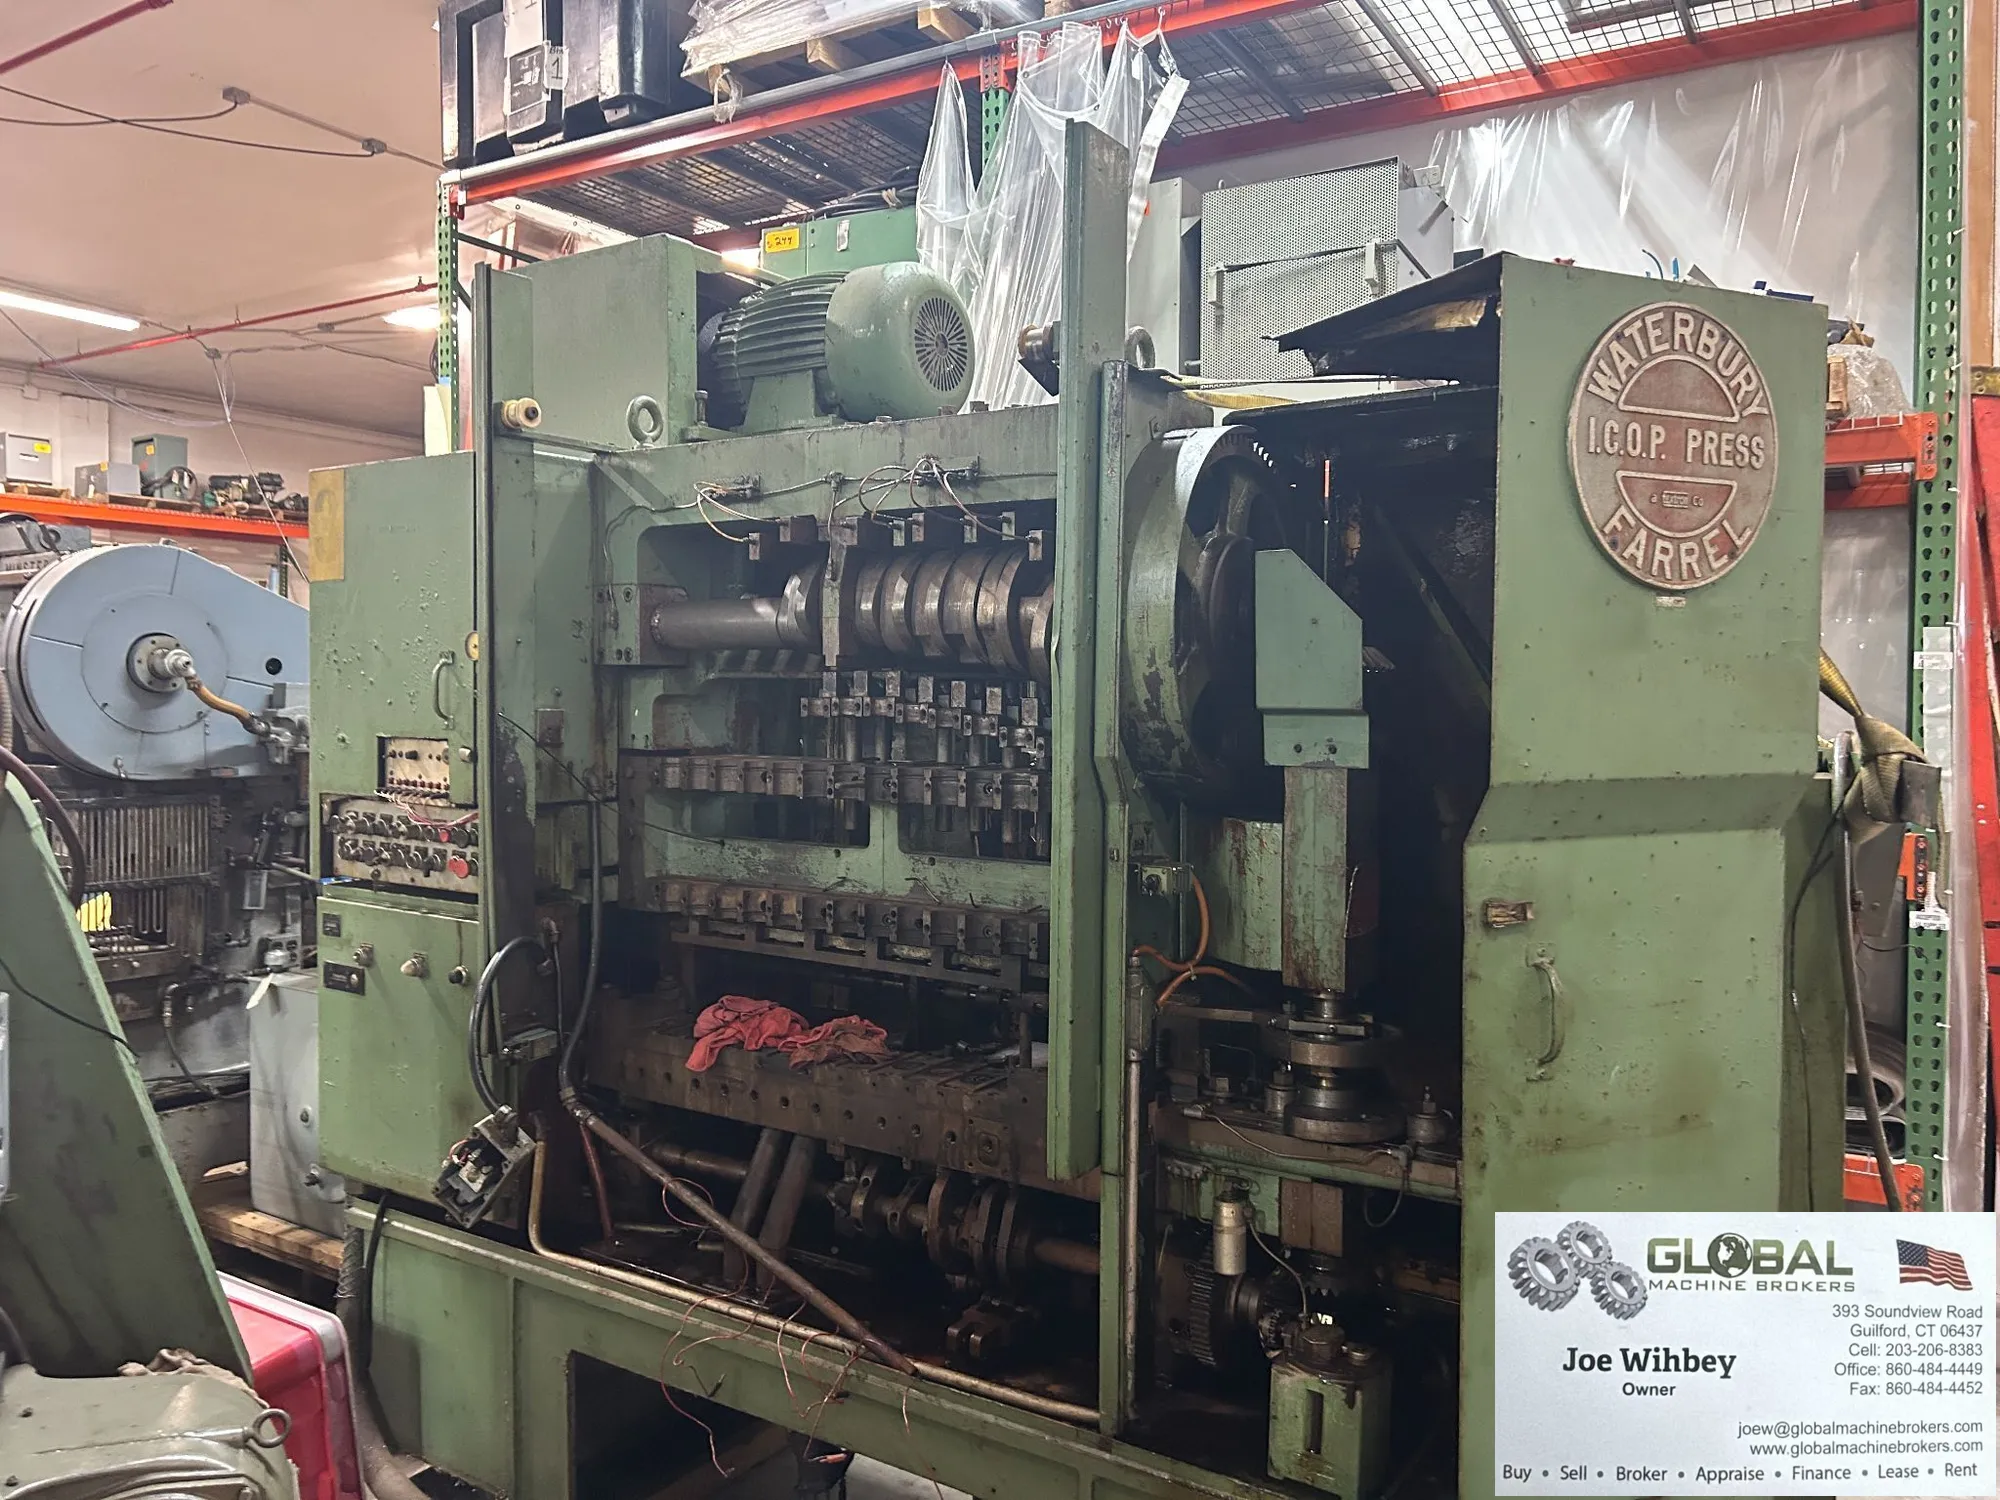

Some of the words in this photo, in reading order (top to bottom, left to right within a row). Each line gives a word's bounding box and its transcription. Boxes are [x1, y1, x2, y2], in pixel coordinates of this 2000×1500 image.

[1587, 311, 1770, 417] WATERBURY
[1587, 416, 1666, 459] I.C.O.P.
[1685, 428, 1765, 469] PRESS
[1602, 505, 1752, 580] FARREL
